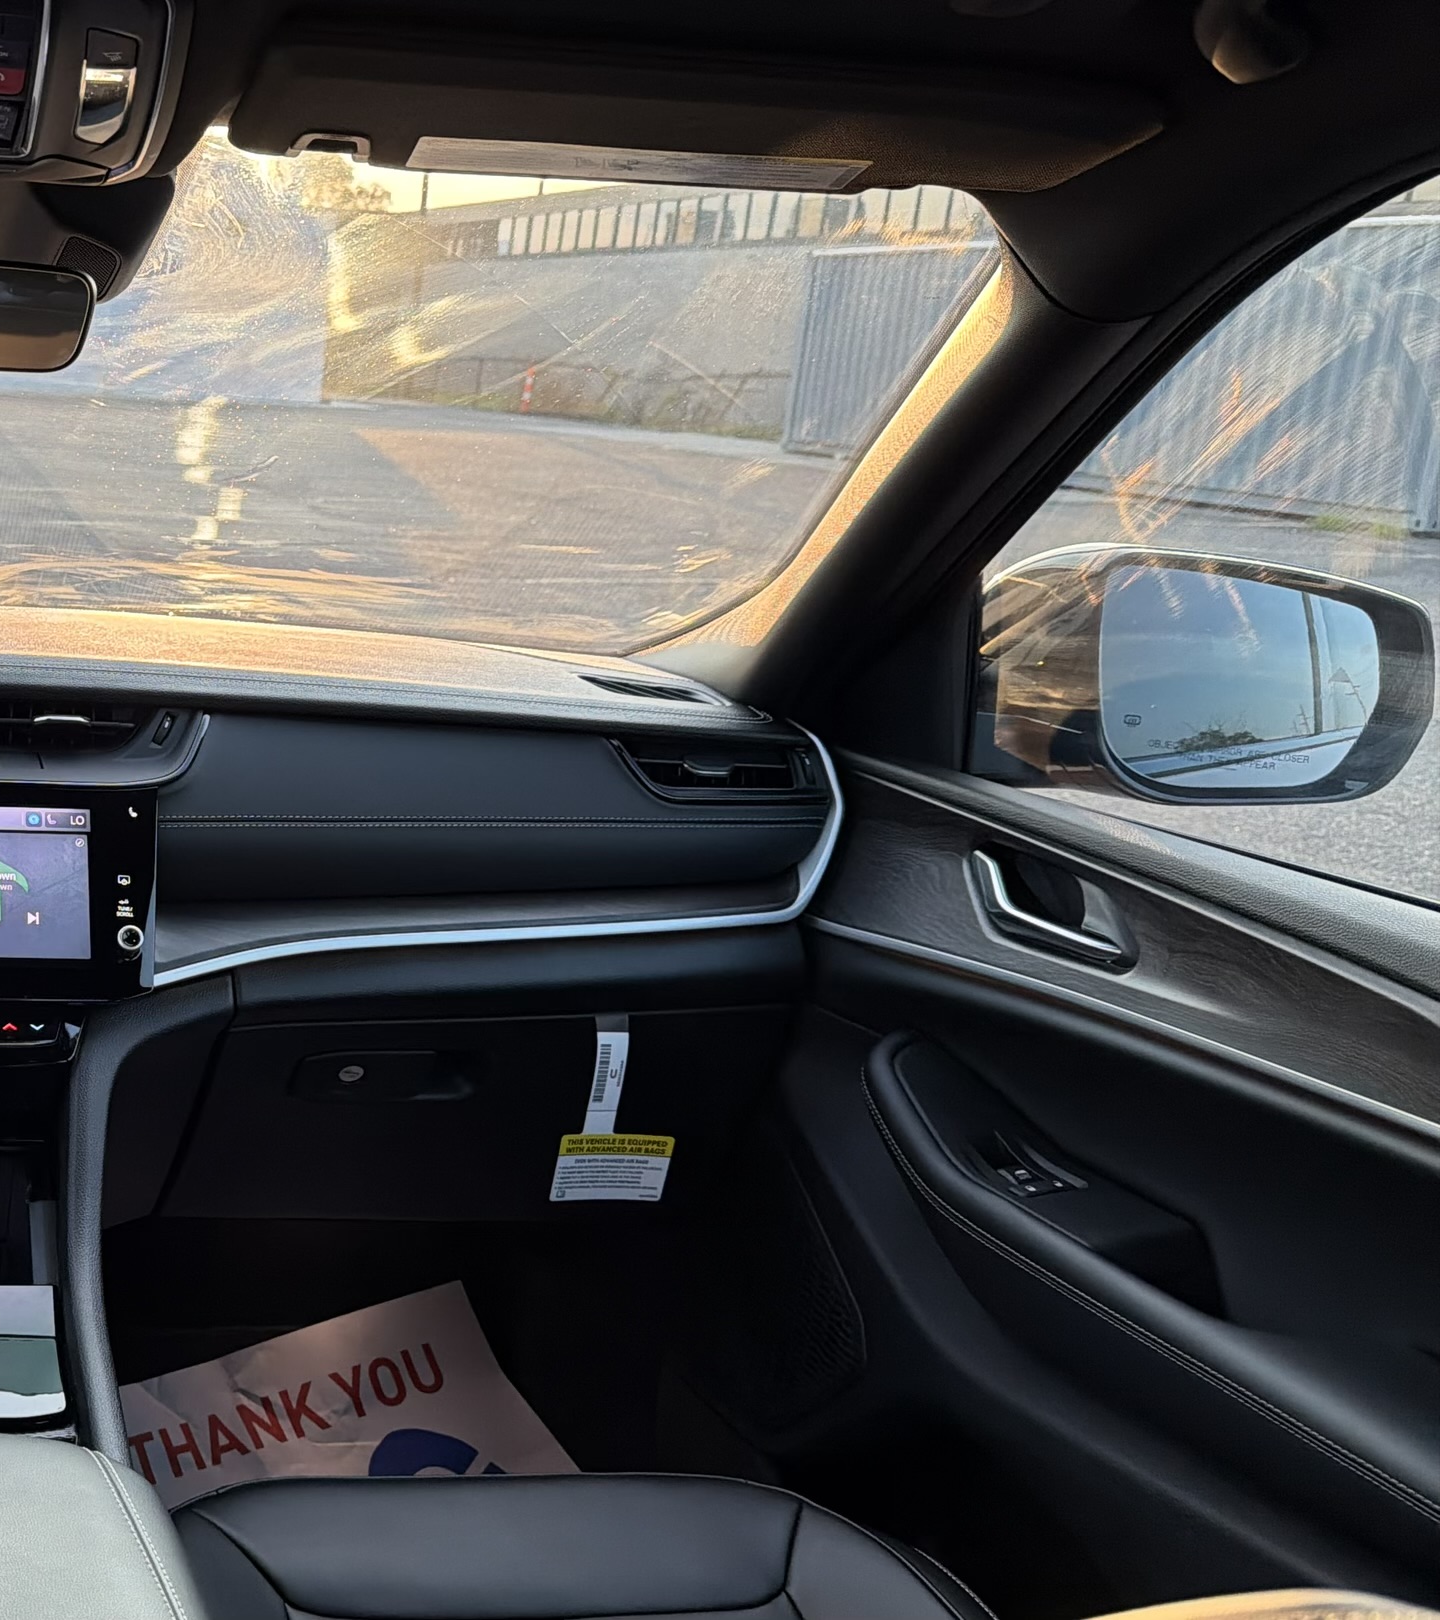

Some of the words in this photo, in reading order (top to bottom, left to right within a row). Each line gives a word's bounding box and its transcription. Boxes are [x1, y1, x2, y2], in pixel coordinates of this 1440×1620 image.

[1271, 752, 1310, 763] CLOSER
[70, 815, 85, 826] LO
[567, 1138, 584, 1146] THIS
[585, 1138, 616, 1146] VEHICLE
[617, 1138, 626, 1146] IS
[627, 1138, 668, 1148] EQUIPPED
[643, 1147, 666, 1155] BAGS
[129, 1381, 331, 1486] THANK
[329, 1343, 444, 1418] YOU
